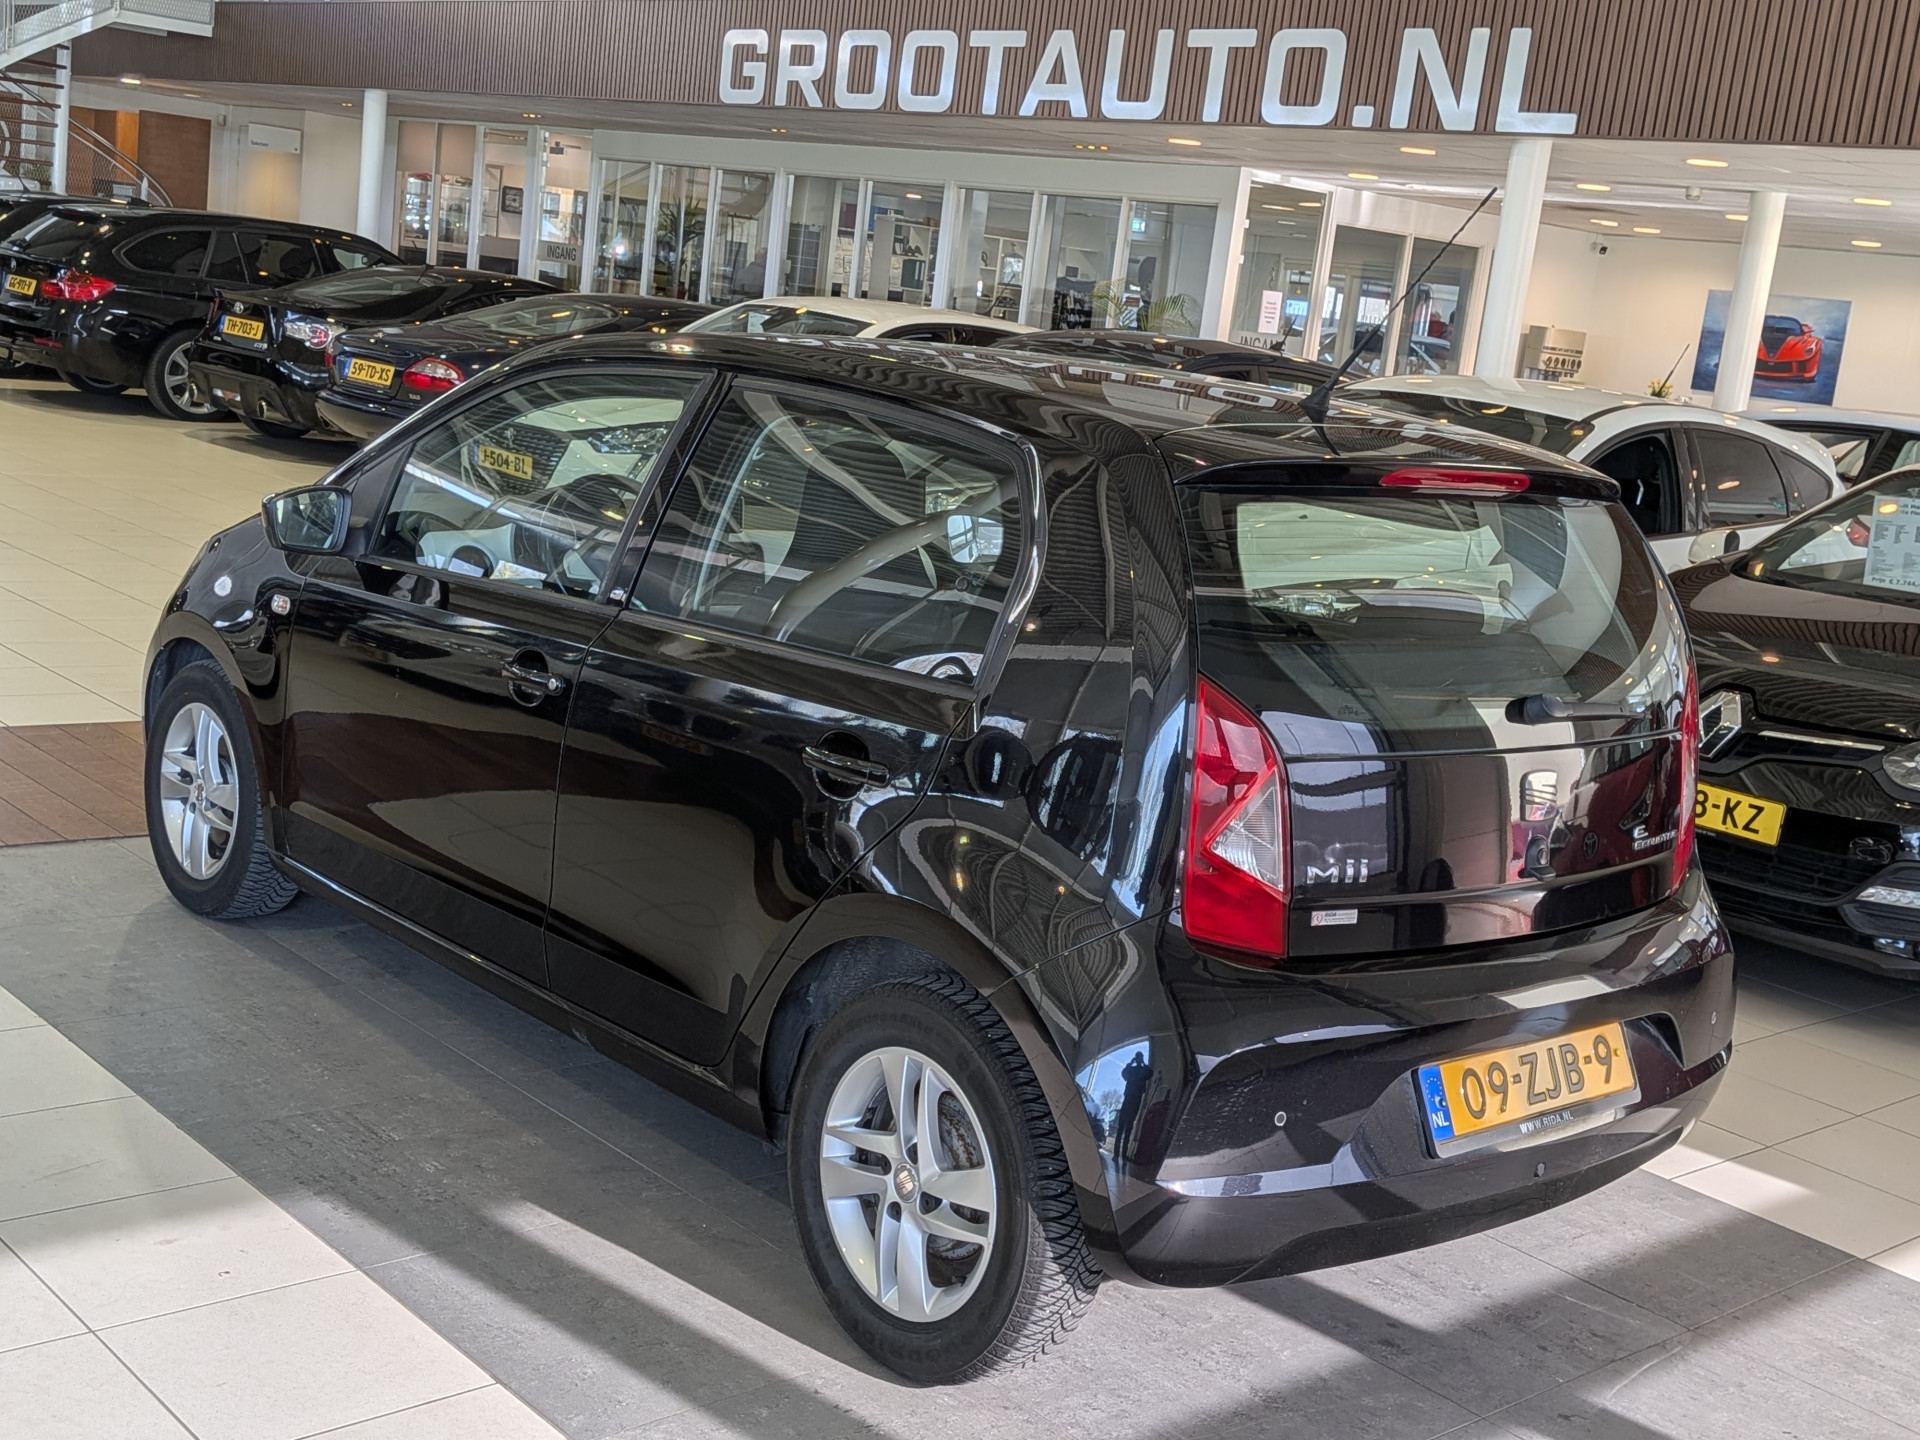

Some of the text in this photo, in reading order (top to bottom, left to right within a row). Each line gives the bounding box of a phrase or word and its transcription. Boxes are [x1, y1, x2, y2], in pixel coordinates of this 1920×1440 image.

[719, 27, 1578, 135] GROOTAUTO.NL
[546, 244, 577, 262] INGANG
[226, 318, 260, 337] TH-703-J
[350, 361, 392, 383] 59-TD-XS
[481, 448, 529, 476] J-504-BL
[1460, 1034, 1613, 1120] 09-ZJB-9
[1431, 1110, 1450, 1129] NL
[1519, 1110, 1574, 1134] WWW.RIDA.NL
